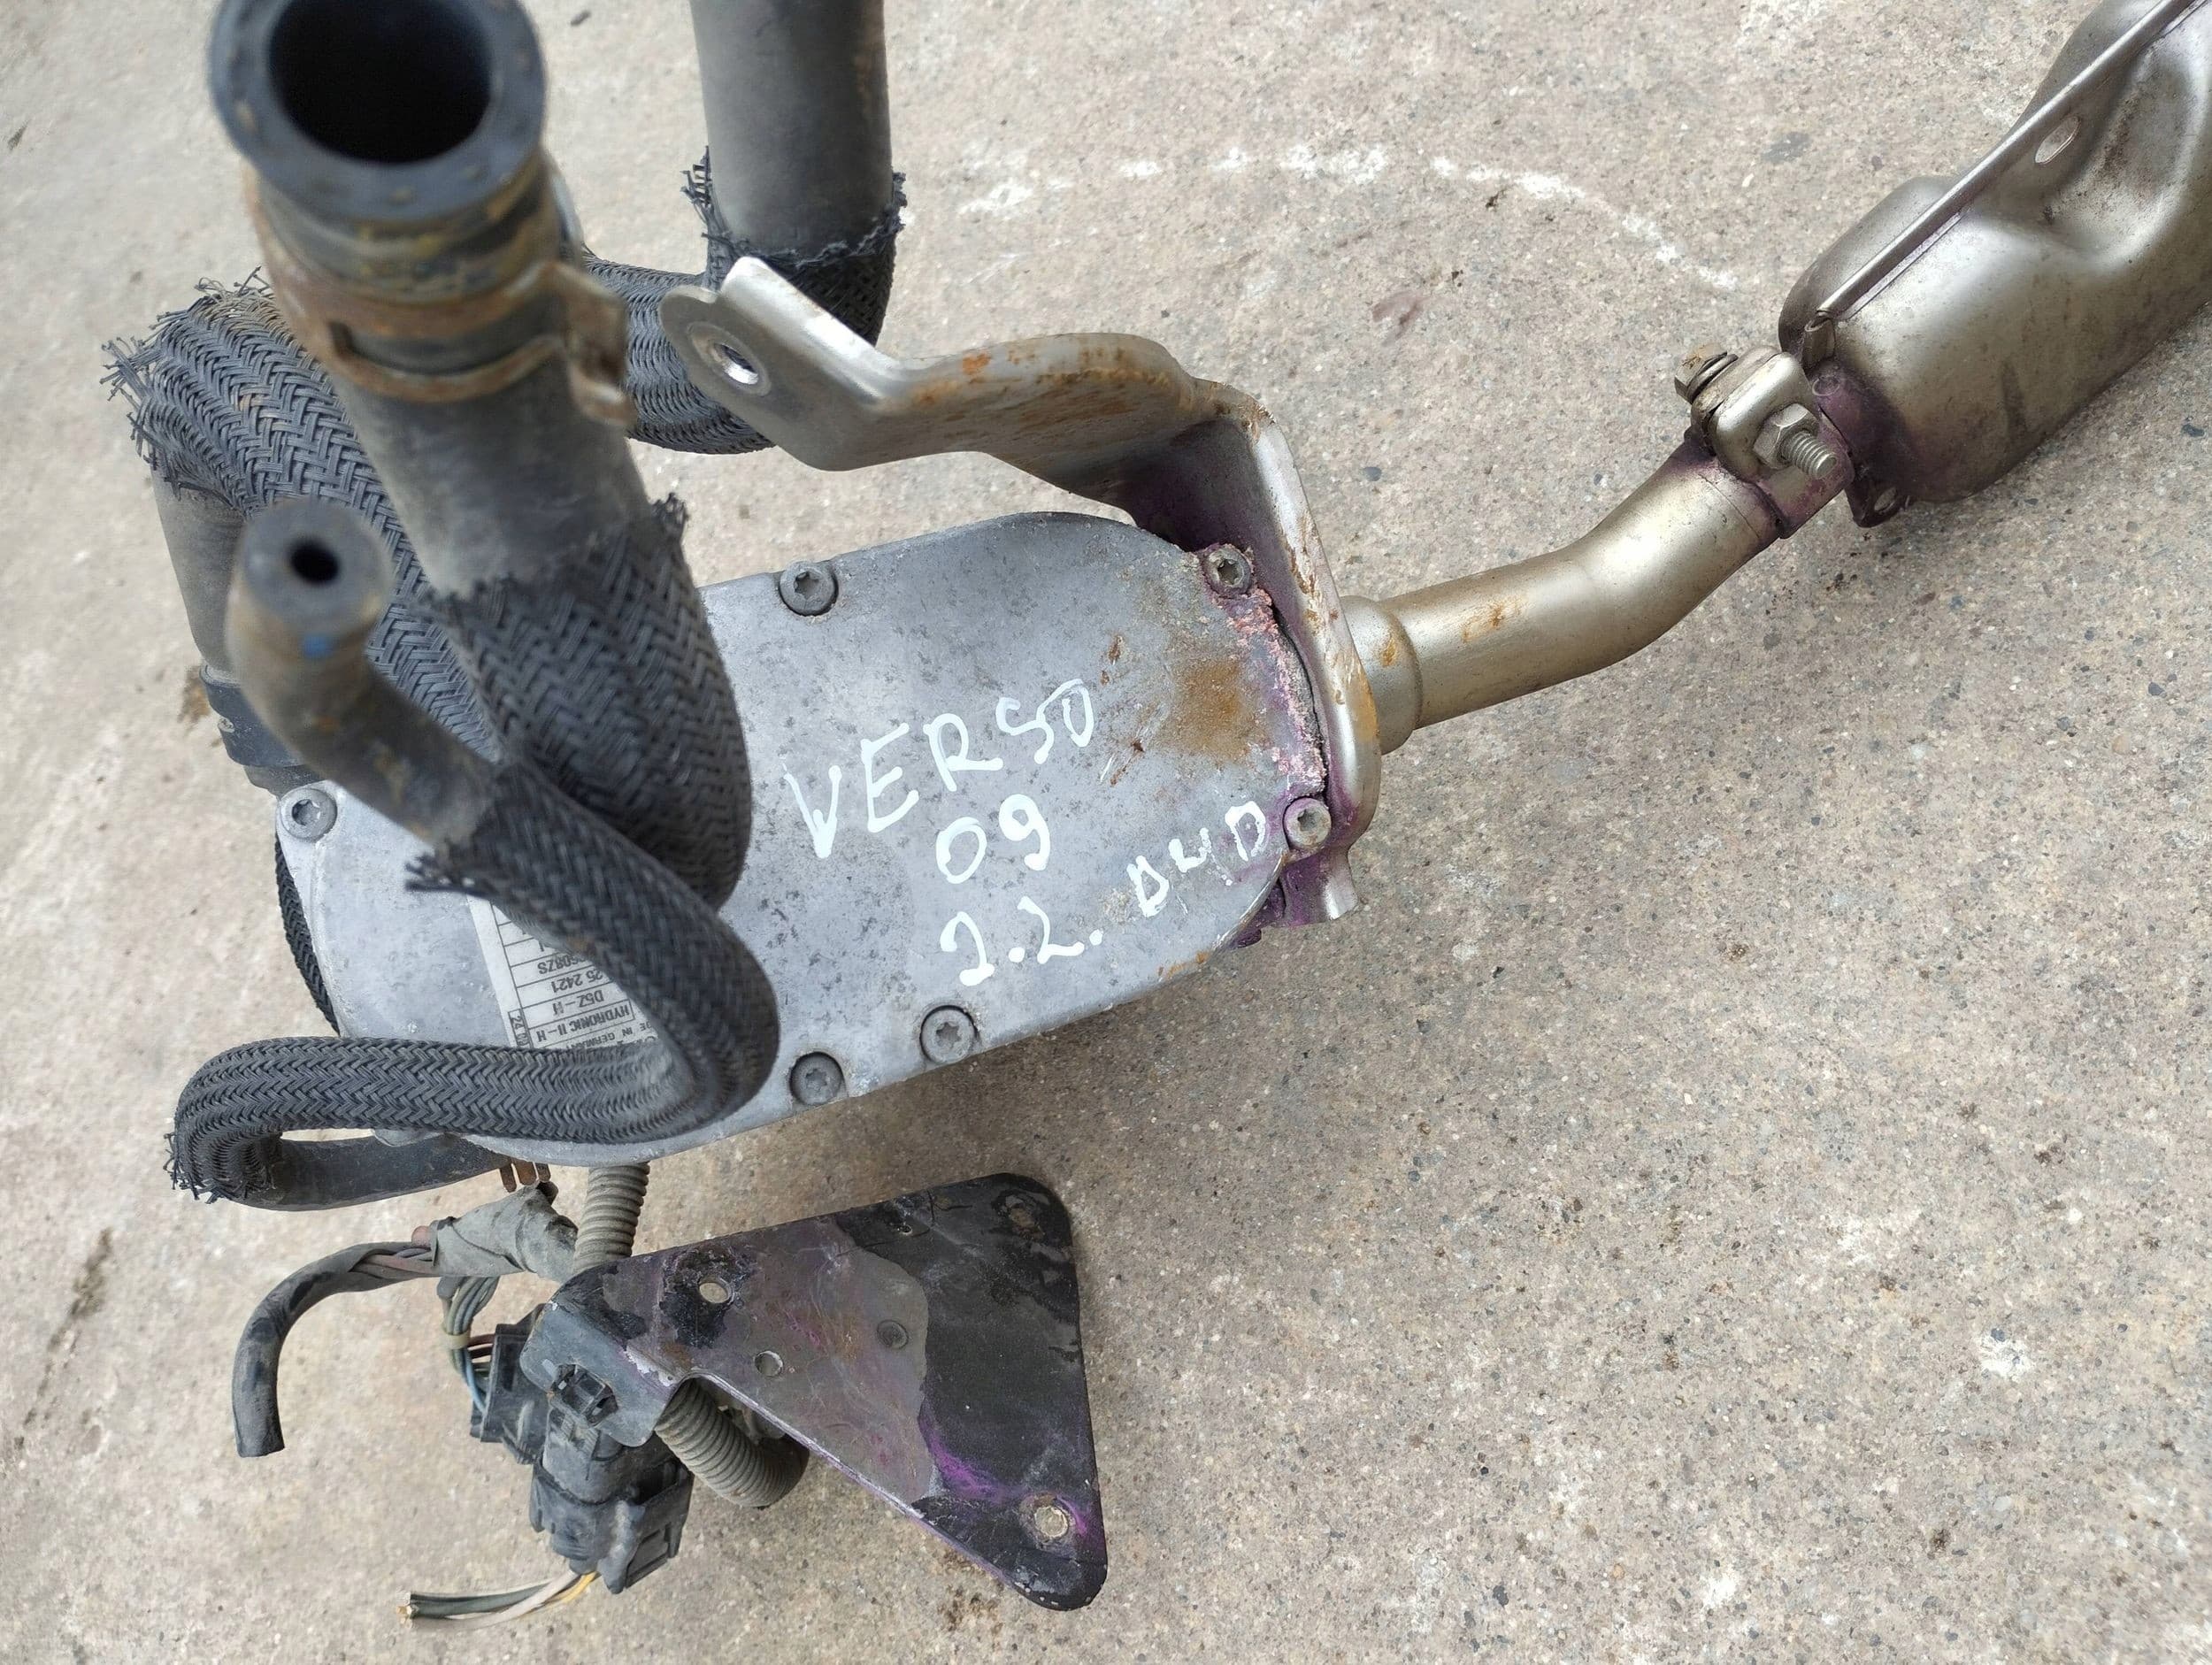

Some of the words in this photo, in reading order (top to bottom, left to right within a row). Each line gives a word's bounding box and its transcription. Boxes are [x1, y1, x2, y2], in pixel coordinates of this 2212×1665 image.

[782, 678, 1094, 858] VERSO
[935, 793, 1051, 884] 09
[551, 975, 583, 994] 2421
[569, 1005, 630, 1032] HYDRONIC
